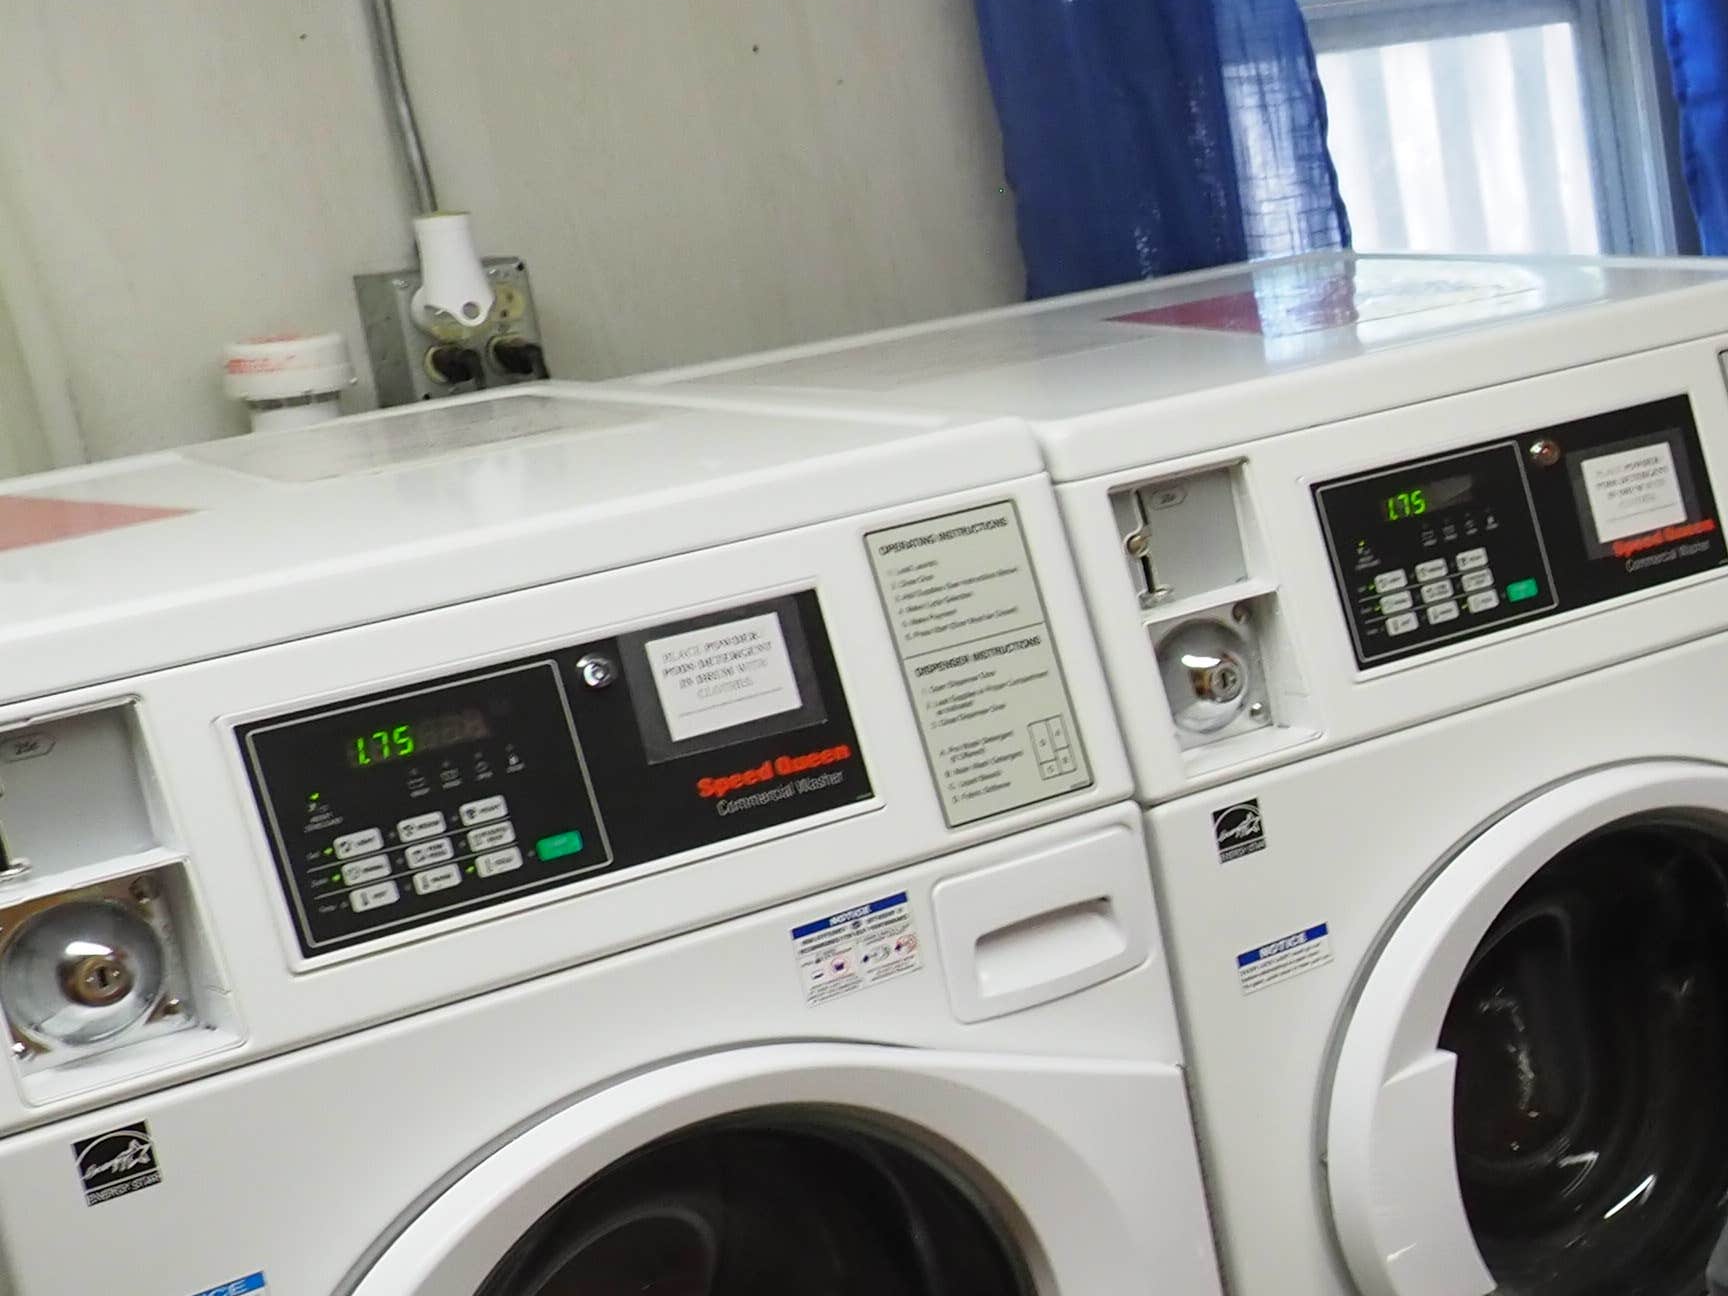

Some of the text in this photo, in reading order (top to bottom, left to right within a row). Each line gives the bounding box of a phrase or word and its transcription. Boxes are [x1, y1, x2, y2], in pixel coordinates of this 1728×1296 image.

[697, 743, 852, 798] Speed Queen
[716, 770, 845, 817] Commercial Washer
